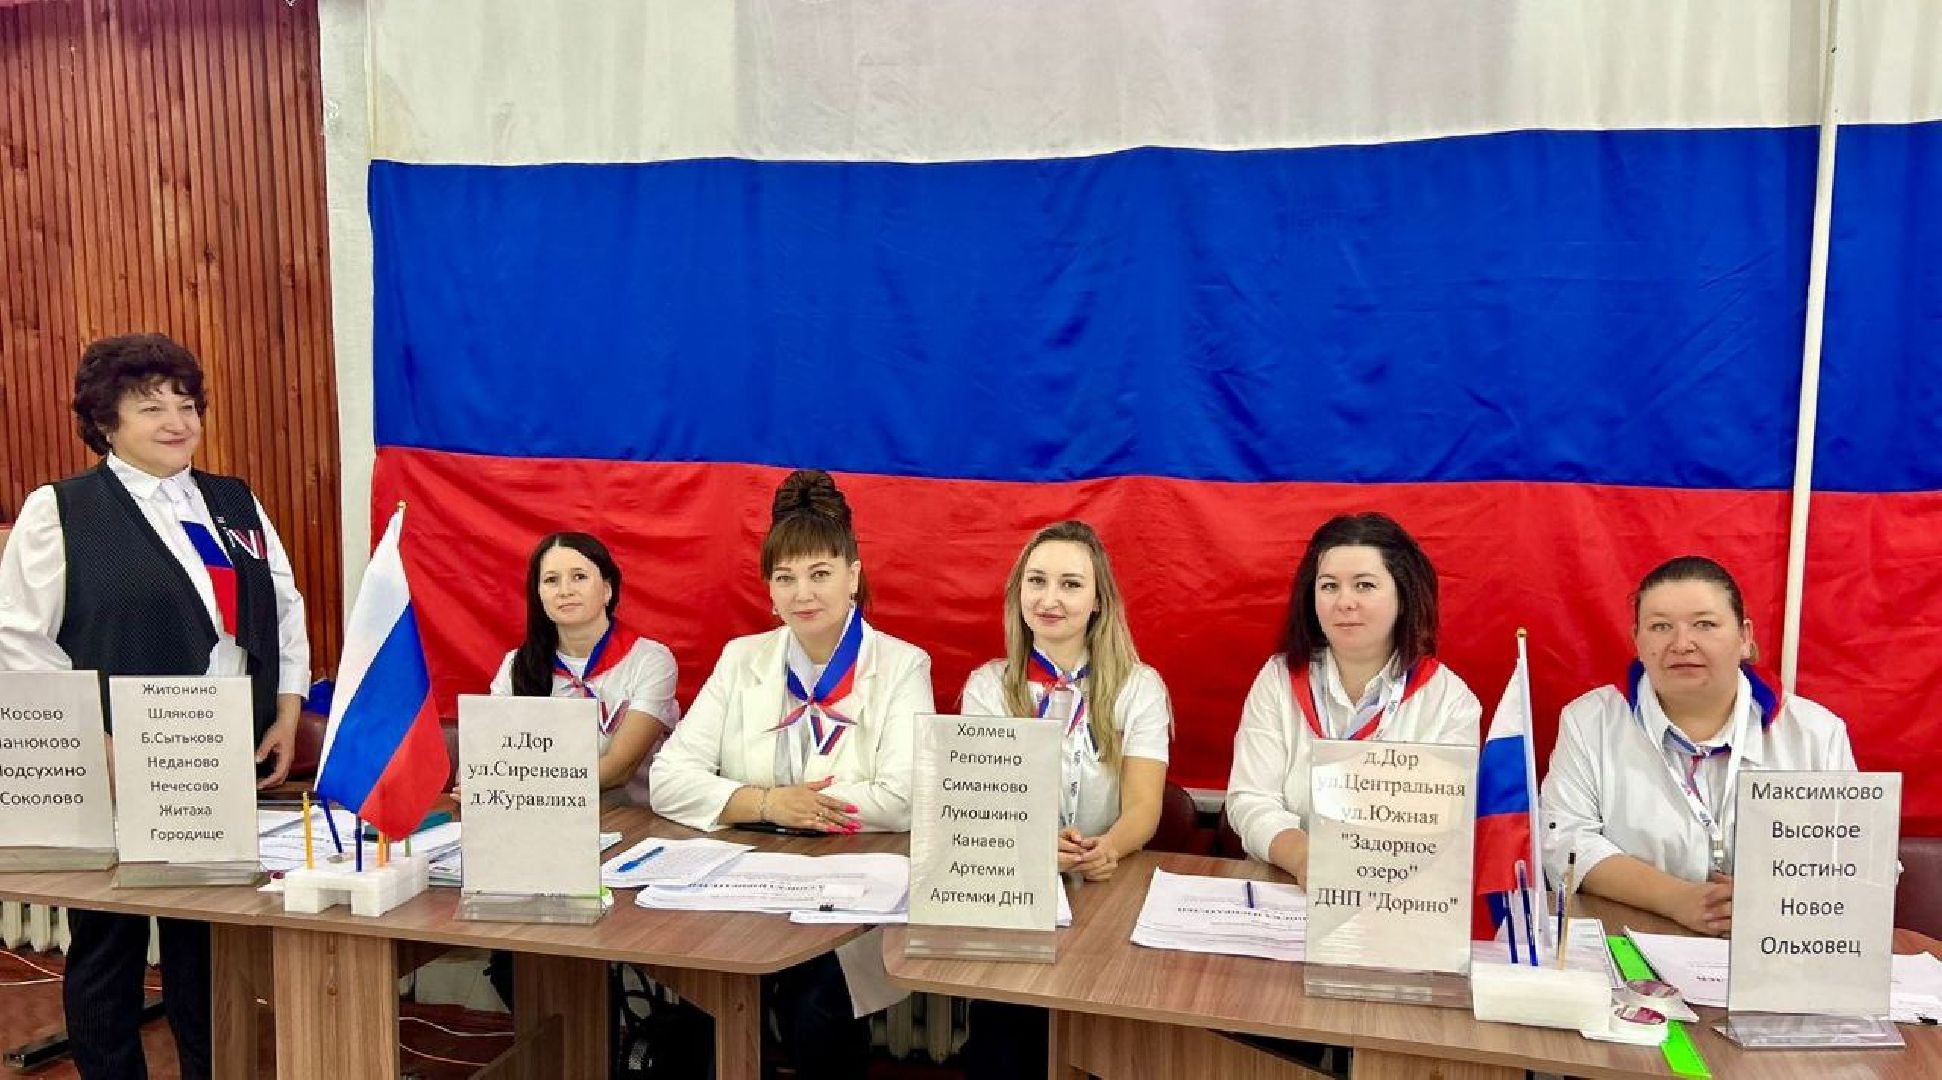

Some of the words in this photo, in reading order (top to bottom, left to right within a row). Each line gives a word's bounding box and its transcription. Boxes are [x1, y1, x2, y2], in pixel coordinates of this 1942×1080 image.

[143, 683, 217, 696] Житонино
[1, 707, 63, 721] Косово
[148, 707, 214, 720] Шляково
[141, 731, 224, 745] Б.Сытьково
[957, 723, 1016, 740] Холмец
[0, 737, 81, 750] анюково
[501, 731, 553, 753] д.Дор
[147, 756, 220, 769] Неданово
[950, 750, 1022, 767] Репотино
[1364, 749, 1419, 769] д.Дор
[468, 760, 588, 780] ул.Сиреневая
[150, 780, 220, 793] Нечесово
[942, 778, 1027, 794] Симанково
[1751, 782, 1883, 801] Максимково
[0, 790, 84, 805] Соколово
[470, 789, 587, 811] д.Журавлиха
[159, 804, 213, 818] Житаха
[940, 805, 1027, 823] Лукошкино
[1341, 805, 1439, 825] ул.Южная
[150, 828, 224, 842] Городище
[1772, 821, 1861, 839] Высокое
[952, 833, 1015, 849] Канаево
[1341, 833, 1437, 857] "Задорное
[949, 861, 1015, 878] Артемки
[1357, 864, 1418, 882] озеро"
[1772, 859, 1858, 878] Костино
[930, 887, 996, 903] Артемки
[998, 891, 1034, 906] ДНП
[1315, 887, 1361, 907] ДНП
[1368, 891, 1459, 915] "Дорино"
[1780, 898, 1845, 916] Новое
[1760, 936, 1861, 956] Ольховец
